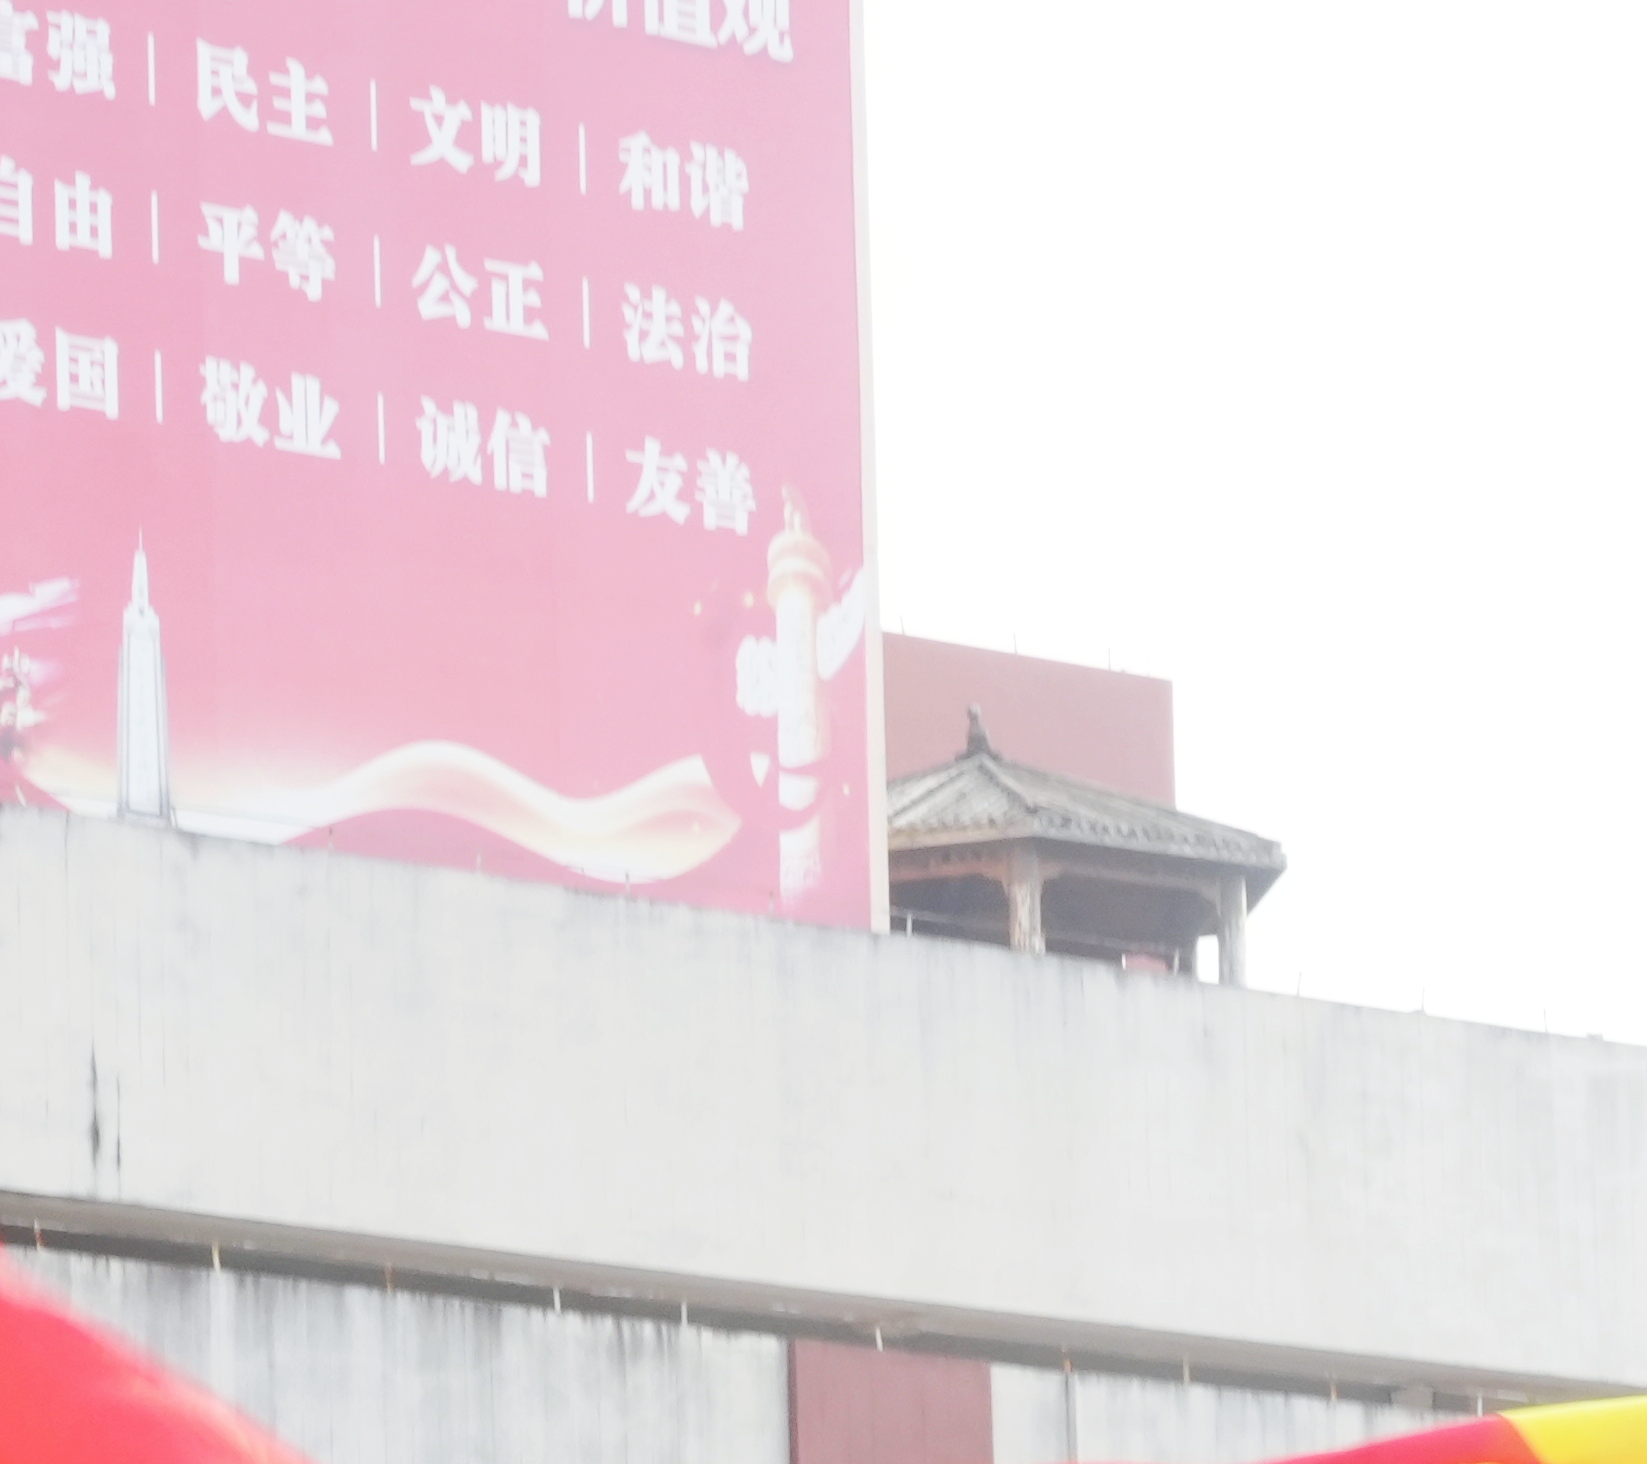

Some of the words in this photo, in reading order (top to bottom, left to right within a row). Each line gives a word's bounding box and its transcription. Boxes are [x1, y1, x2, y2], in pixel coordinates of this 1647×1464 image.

[568, 0, 793, 62] 值观
[196, 38, 333, 146] 民主
[410, 85, 541, 187] 文明
[619, 131, 749, 230] 和谐
[198, 202, 336, 301] 平等
[412, 244, 549, 340] 公正
[622, 283, 752, 381] 法治
[200, 355, 341, 459] 敬业
[416, 396, 550, 498] 诚信
[626, 436, 756, 536] 友善
